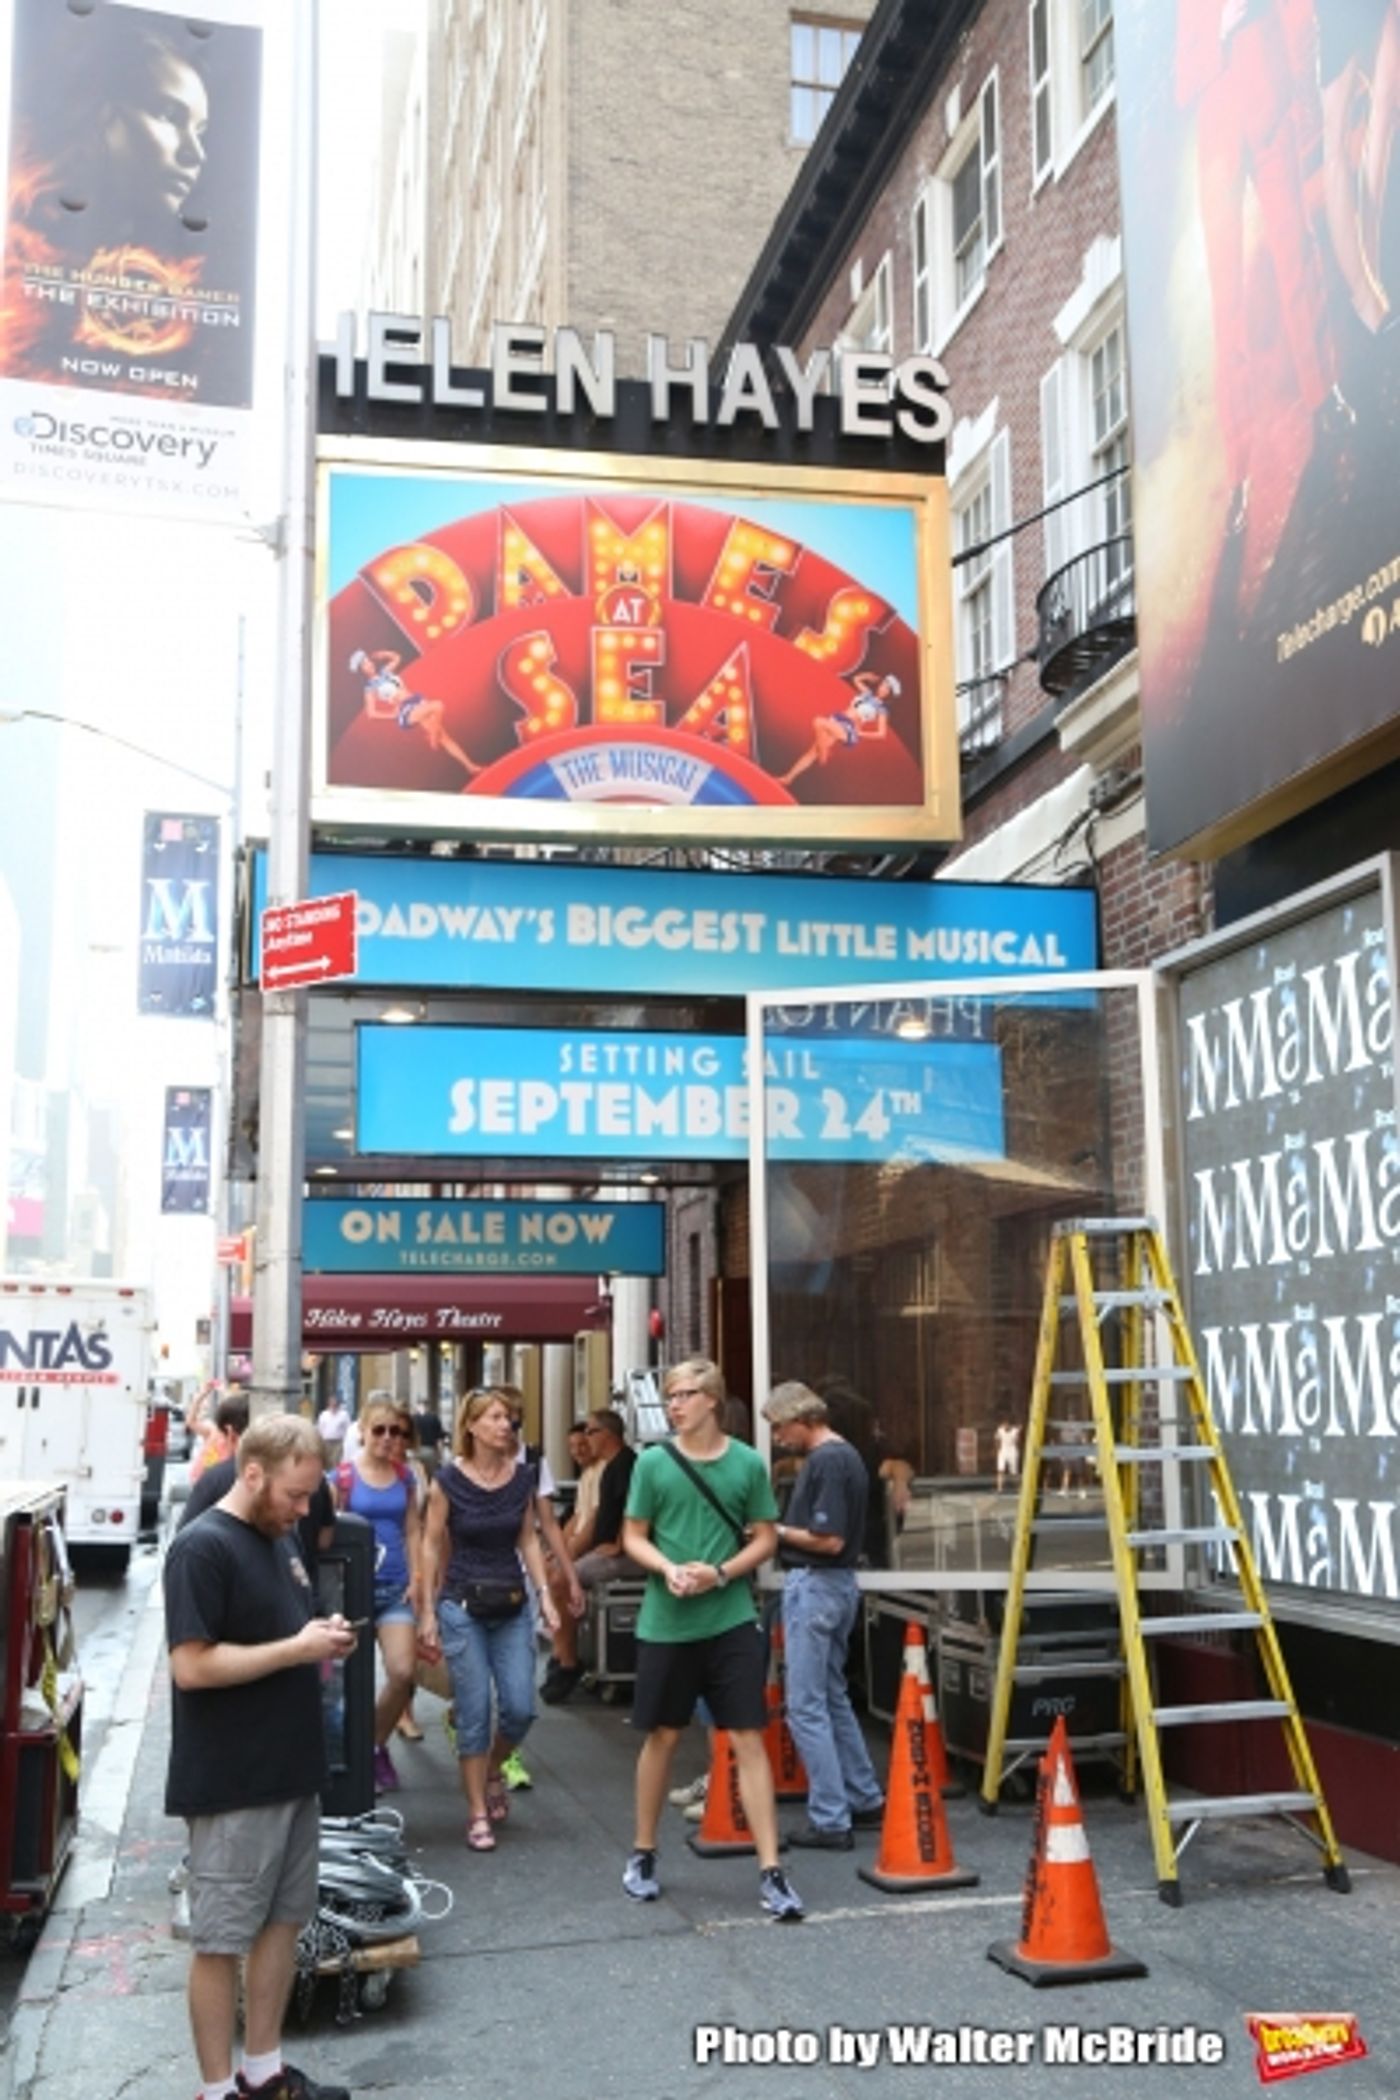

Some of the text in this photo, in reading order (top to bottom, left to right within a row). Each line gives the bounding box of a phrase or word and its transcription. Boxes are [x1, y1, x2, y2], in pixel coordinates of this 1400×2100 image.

[23, 283, 240, 327] THE EXHIBITION
[61, 355, 199, 389] NOW OPEN
[650, 332, 954, 443] HAYES
[28, 442, 147, 467] TIMES SQUARE
[359, 498, 897, 676] DAMES
[612, 597, 646, 625] AT
[498, 626, 757, 760] SEA
[560, 752, 606, 789] THE
[355, 900, 1066, 967] OADWAY'S BIGGEST LITTLE MUSICAL
[559, 1043, 721, 1077] SETTING
[448, 1077, 805, 1141] SEPTEMBER
[340, 1209, 615, 1245] ON SALE NOW
[399, 1250, 558, 1267] TELECHARGE.COM
[302, 1307, 503, 1331] Helen Hayes Theatre
